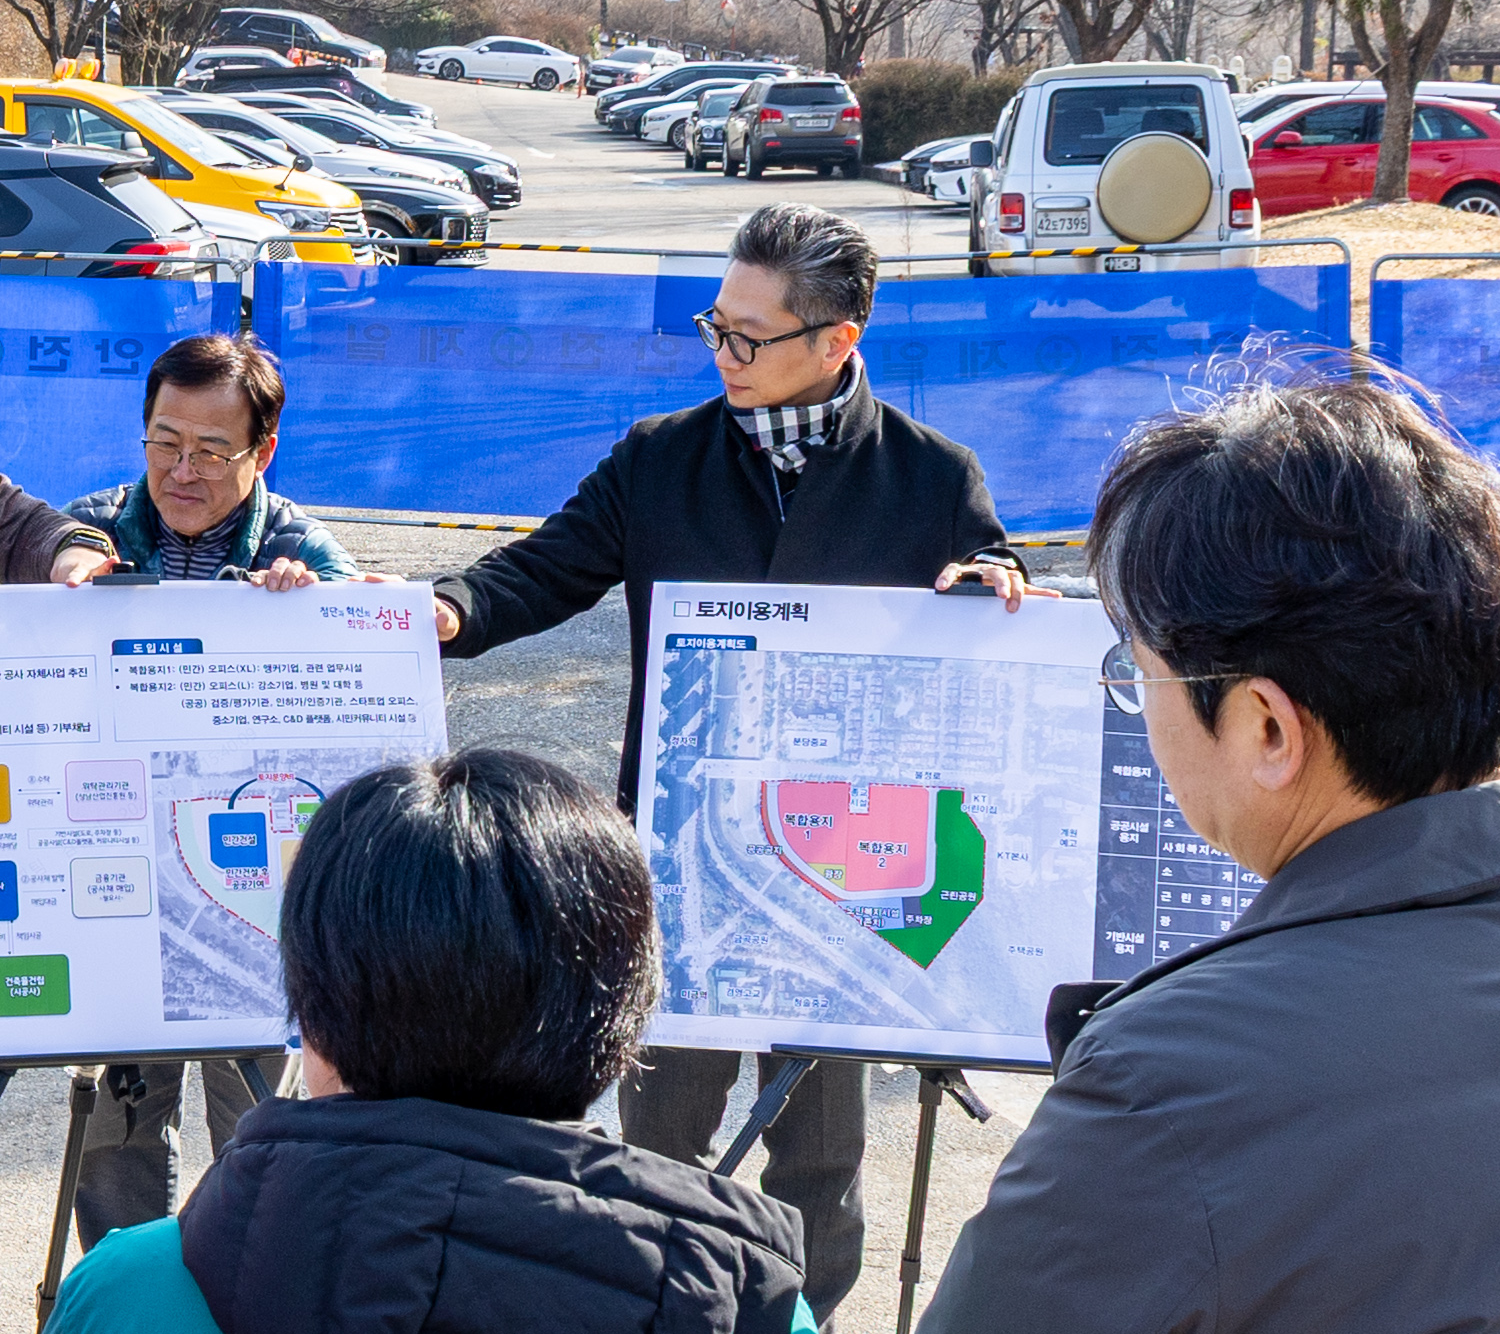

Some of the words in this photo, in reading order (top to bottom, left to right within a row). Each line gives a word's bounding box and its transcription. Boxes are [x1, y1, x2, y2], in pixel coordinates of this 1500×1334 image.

[696, 600, 809, 622] 토지이용계획
[375, 606, 412, 630] 성남
[675, 637, 747, 649] 토지이용계획도
[3, 668, 24, 681] 공사
[25, 667, 66, 680] 자체사업
[67, 666, 88, 678] 추진
[178, 664, 205, 675] (민간)
[305, 663, 324, 673] 관련
[325, 663, 363, 673] 업무시설
[1111, 765, 1152, 778] 복합용지
[783, 814, 833, 828] 복합용지
[1110, 820, 1149, 833] 공공시설
[221, 833, 258, 847] 민간건설
[1119, 833, 1140, 843] 용지
[858, 841, 907, 855] 복합용지
[878, 857, 886, 868] 2
[94, 872, 126, 884] 금융기관
[940, 890, 978, 902] 근린공원
[1105, 932, 1145, 944] 기반시설
[1114, 944, 1135, 955] 용지
